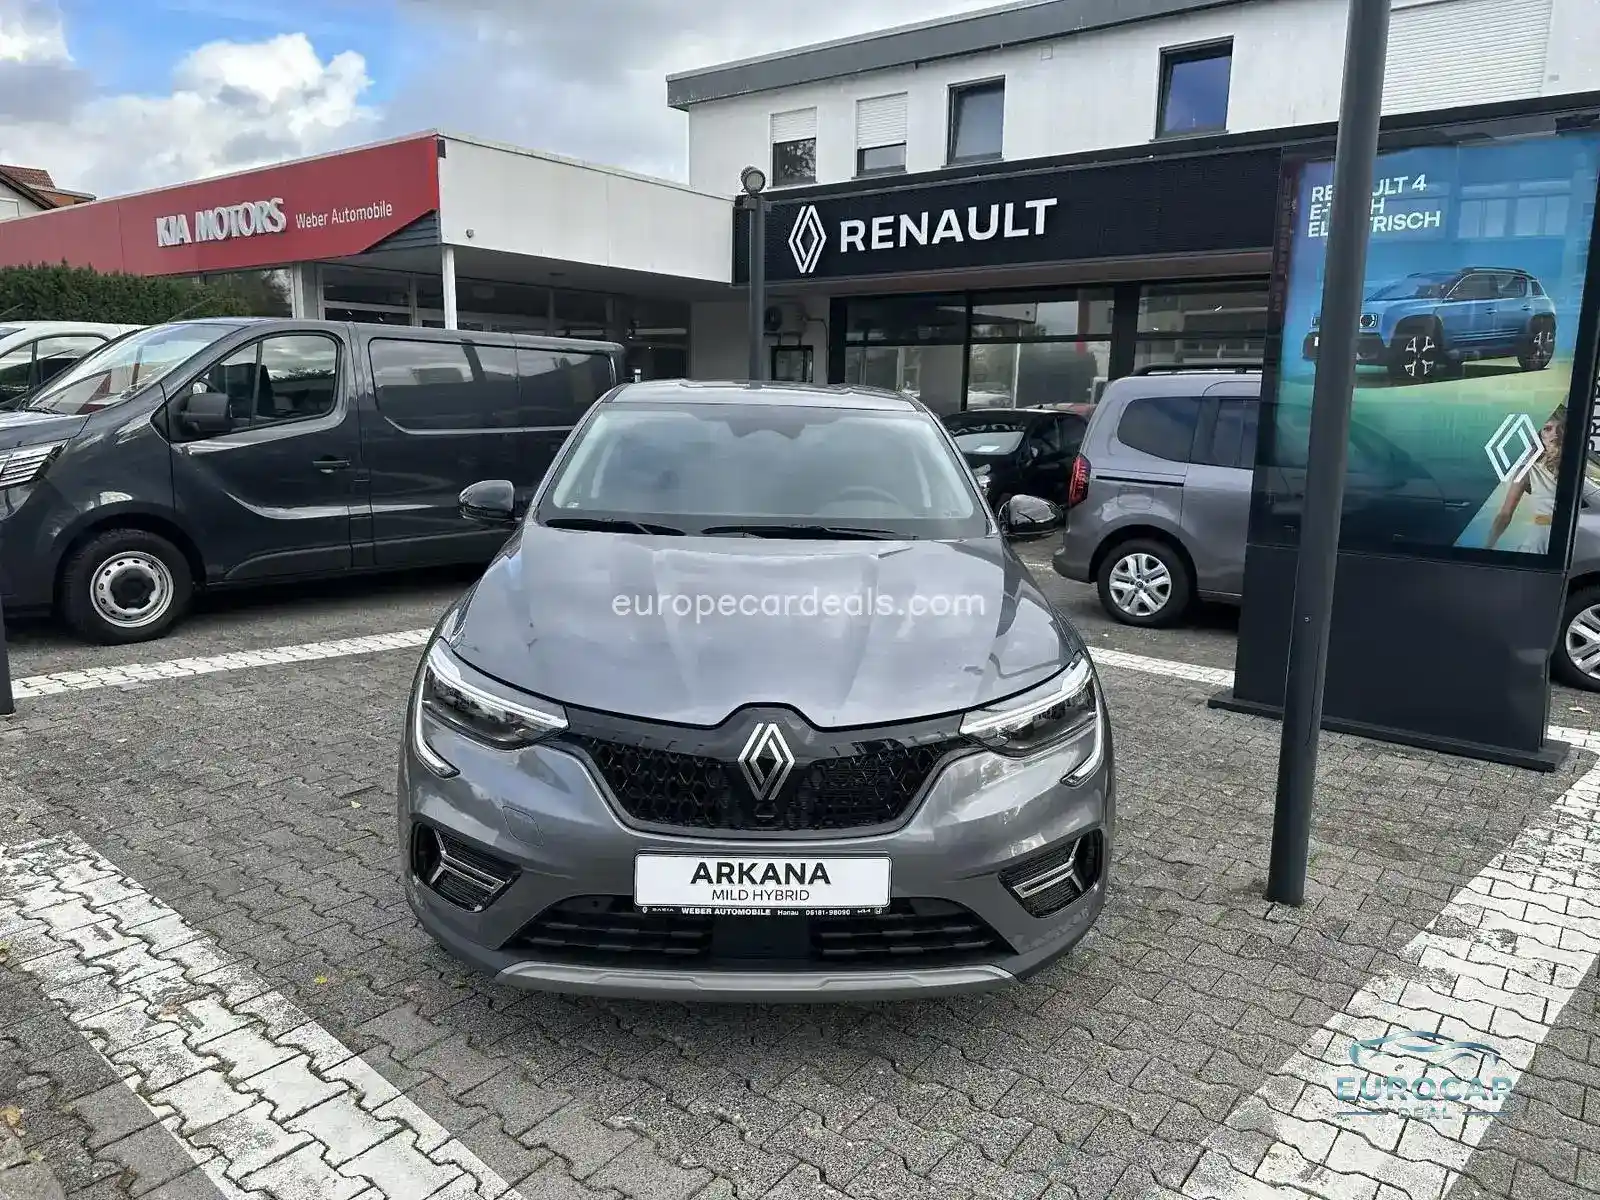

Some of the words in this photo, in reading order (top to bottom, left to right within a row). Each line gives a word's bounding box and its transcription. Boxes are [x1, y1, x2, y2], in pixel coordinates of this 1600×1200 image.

[1311, 176, 1409, 203] REULT
[1411, 173, 1428, 192] 4
[156, 214, 192, 247] KIA
[195, 198, 288, 242] MOTORS
[295, 211, 329, 230] Weber
[331, 200, 394, 225] Automobile
[840, 198, 1058, 253] RENAULT
[690, 861, 831, 885] ARKANA
[711, 889, 749, 901] MILD
[752, 889, 810, 901] HYBRID
[681, 907, 712, 915] WEBER
[714, 908, 771, 916] AUTOMOBILE
